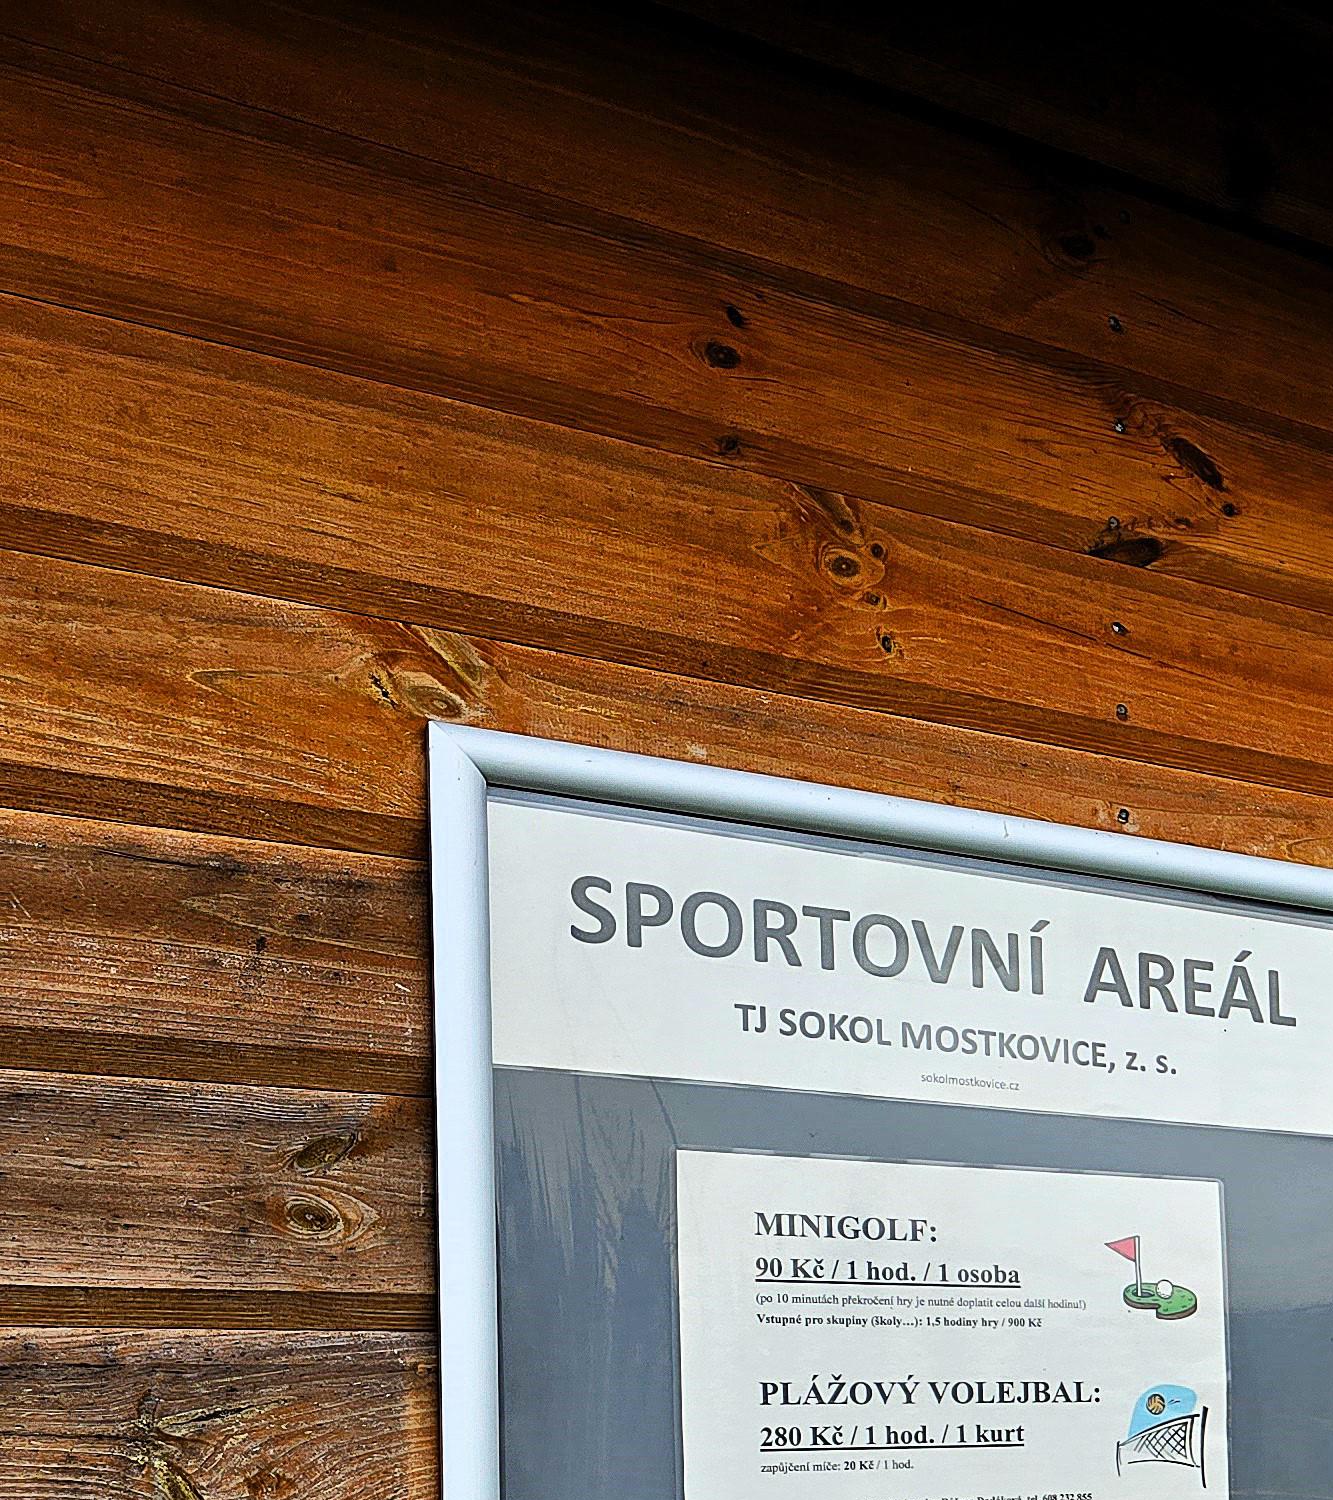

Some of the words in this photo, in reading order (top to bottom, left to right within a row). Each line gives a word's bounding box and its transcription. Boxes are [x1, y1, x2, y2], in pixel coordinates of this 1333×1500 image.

[569, 876, 1048, 996] SPORTOVNÍ
[1084, 946, 1298, 1028] AREÁL
[734, 1003, 767, 1033] TJ
[779, 1009, 892, 1047] SOKOL
[901, 1021, 1116, 1073] MOSTKOVICE,
[1125, 1051, 1146, 1071] z.
[1156, 1054, 1177, 1074] s.
[921, 1072, 1020, 1091] sokolmostkovice.cz
[754, 1211, 938, 1243] MINIGOLF:
[755, 1257, 783, 1278] 90
[790, 1257, 825, 1279] Kč
[866, 1260, 916, 1282] hod.
[957, 1263, 1020, 1284] osoba
[755, 1293, 773, 1307] (po
[777, 1293, 788, 1303] 10
[792, 1294, 839, 1305] minutách
[842, 1295, 894, 1307] překročení
[897, 1296, 913, 1308] hry
[915, 1296, 925, 1308] je
[928, 1297, 954, 1307] nutné
[957, 1297, 993, 1309] doplatit
[996, 1298, 1021, 1308] celou
[1024, 1298, 1045, 1308] další
[1047, 1299, 1087, 1310] hodinu!)
[757, 1313, 802, 1326] Vstupné
[805, 1317, 823, 1326] pro
[827, 1316, 868, 1327] skupiny
[926, 1317, 941, 1327] 1,5
[944, 1317, 978, 1329] hodiny
[981, 1318, 999, 1329] hry
[1008, 1318, 1025, 1327] 900
[1028, 1318, 1042, 1328] Kč
[759, 1374, 918, 1407] PLÁŽOVÝ
[929, 1380, 1101, 1404] VOLEJBAL:
[760, 1427, 802, 1447] 280
[810, 1425, 843, 1446] Kč
[885, 1425, 935, 1445] hod.
[976, 1424, 1025, 1443] kurt
[761, 1462, 810, 1475] zapůjčení
[813, 1462, 841, 1471] míče:
[844, 1461, 856, 1470] 20
[859, 1461, 874, 1470] Kč
[892, 1460, 914, 1469] hod.
[1077, 1493, 1092, 1500] 855
